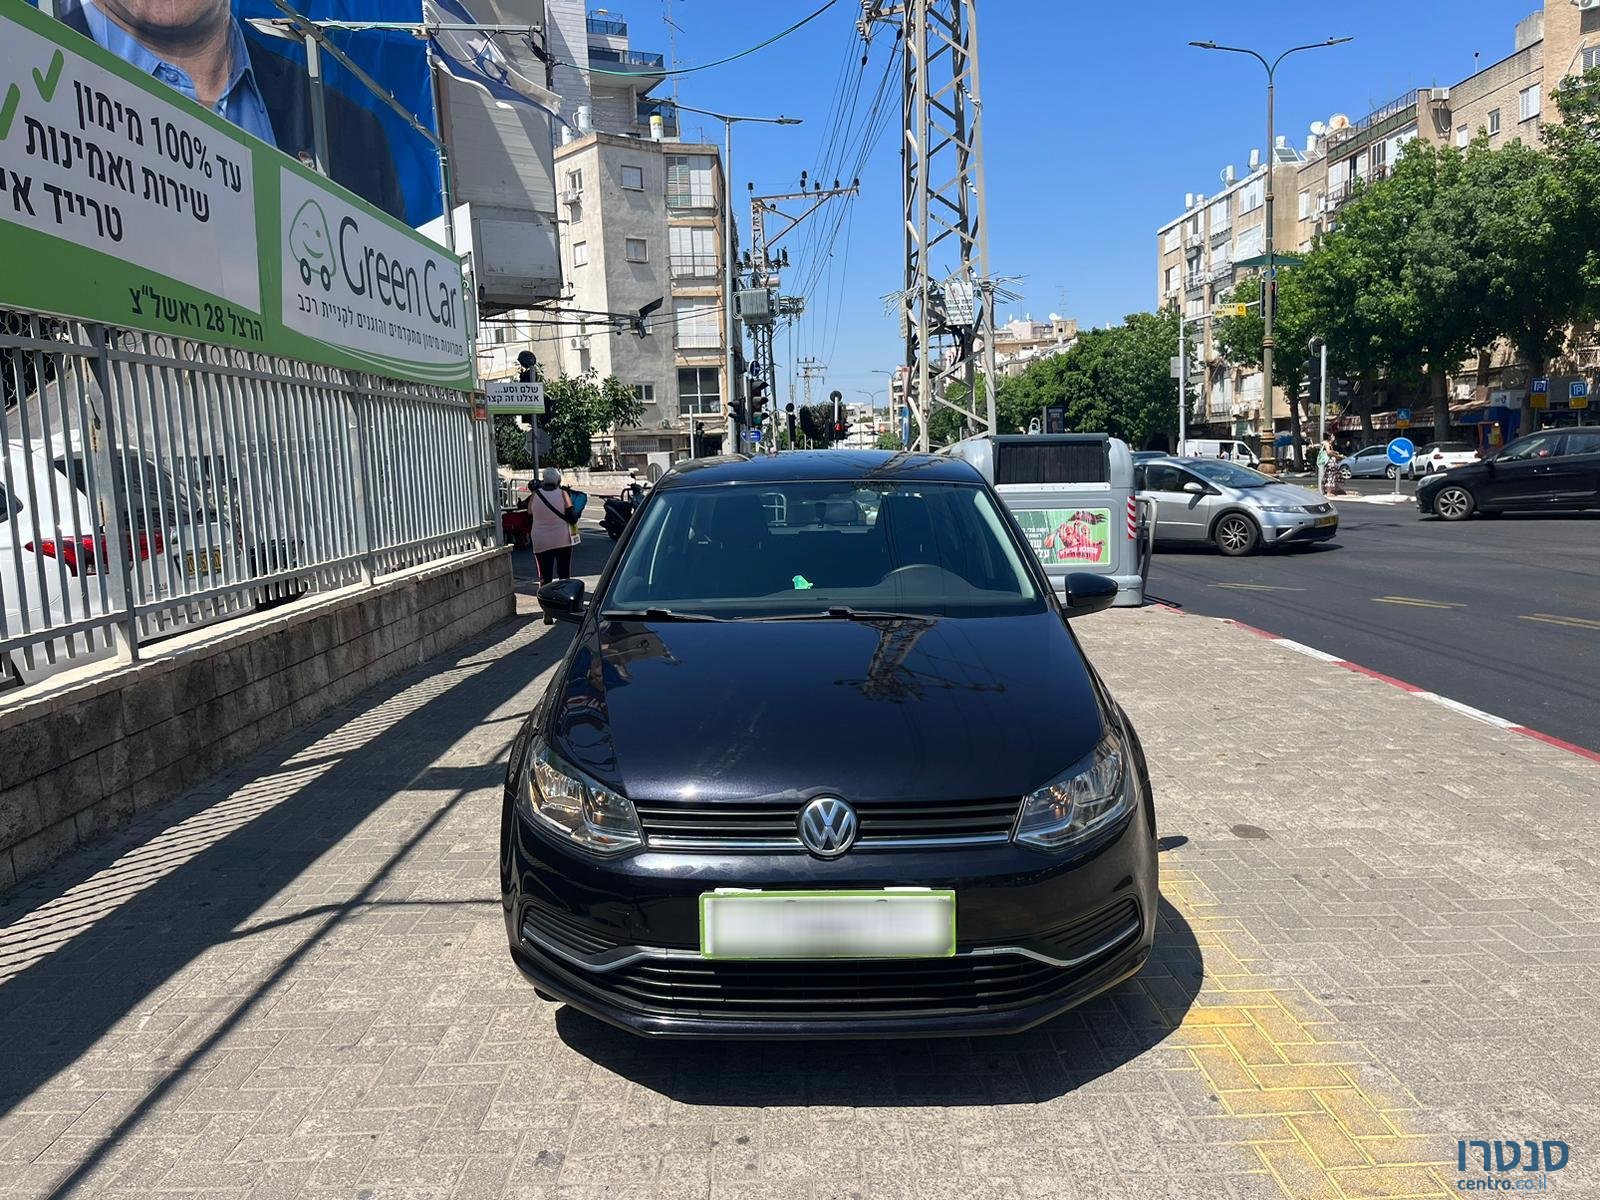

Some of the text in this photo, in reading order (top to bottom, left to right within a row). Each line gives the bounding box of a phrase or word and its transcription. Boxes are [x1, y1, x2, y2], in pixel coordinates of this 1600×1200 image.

[73, 80, 242, 193] עד 100% מימון
[24, 115, 210, 222] שירות ואמינות
[43, 182, 124, 242] טרייד
[339, 215, 457, 329] Green Car
[204, 302, 224, 333] 28
[297, 293, 319, 316] רכב
[321, 301, 354, 328] לקניית
[227, 307, 264, 341] הרצל
[357, 313, 387, 334] והוגנים
[389, 322, 422, 346] מתקדמים
[516, 394, 539, 402] אצלנו
[520, 385, 539, 393] שלם
[801, 797, 857, 855] VW
